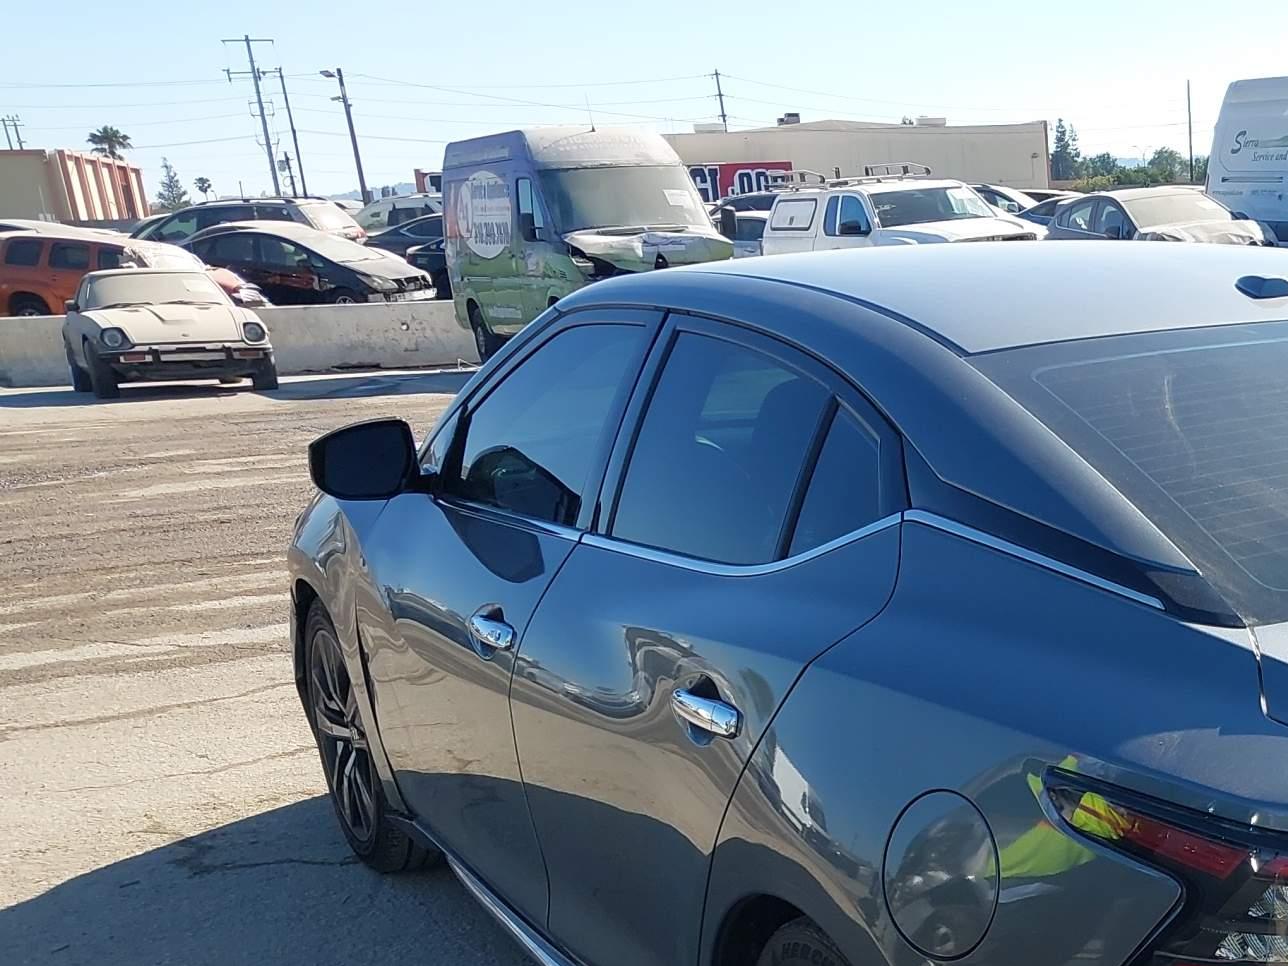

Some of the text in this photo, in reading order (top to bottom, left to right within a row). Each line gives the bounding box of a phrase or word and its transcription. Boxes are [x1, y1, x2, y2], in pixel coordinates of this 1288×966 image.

[1230, 130, 1260, 155] Sierra
[1251, 151, 1275, 162] Service
[1275, 150, 1288, 161] and
